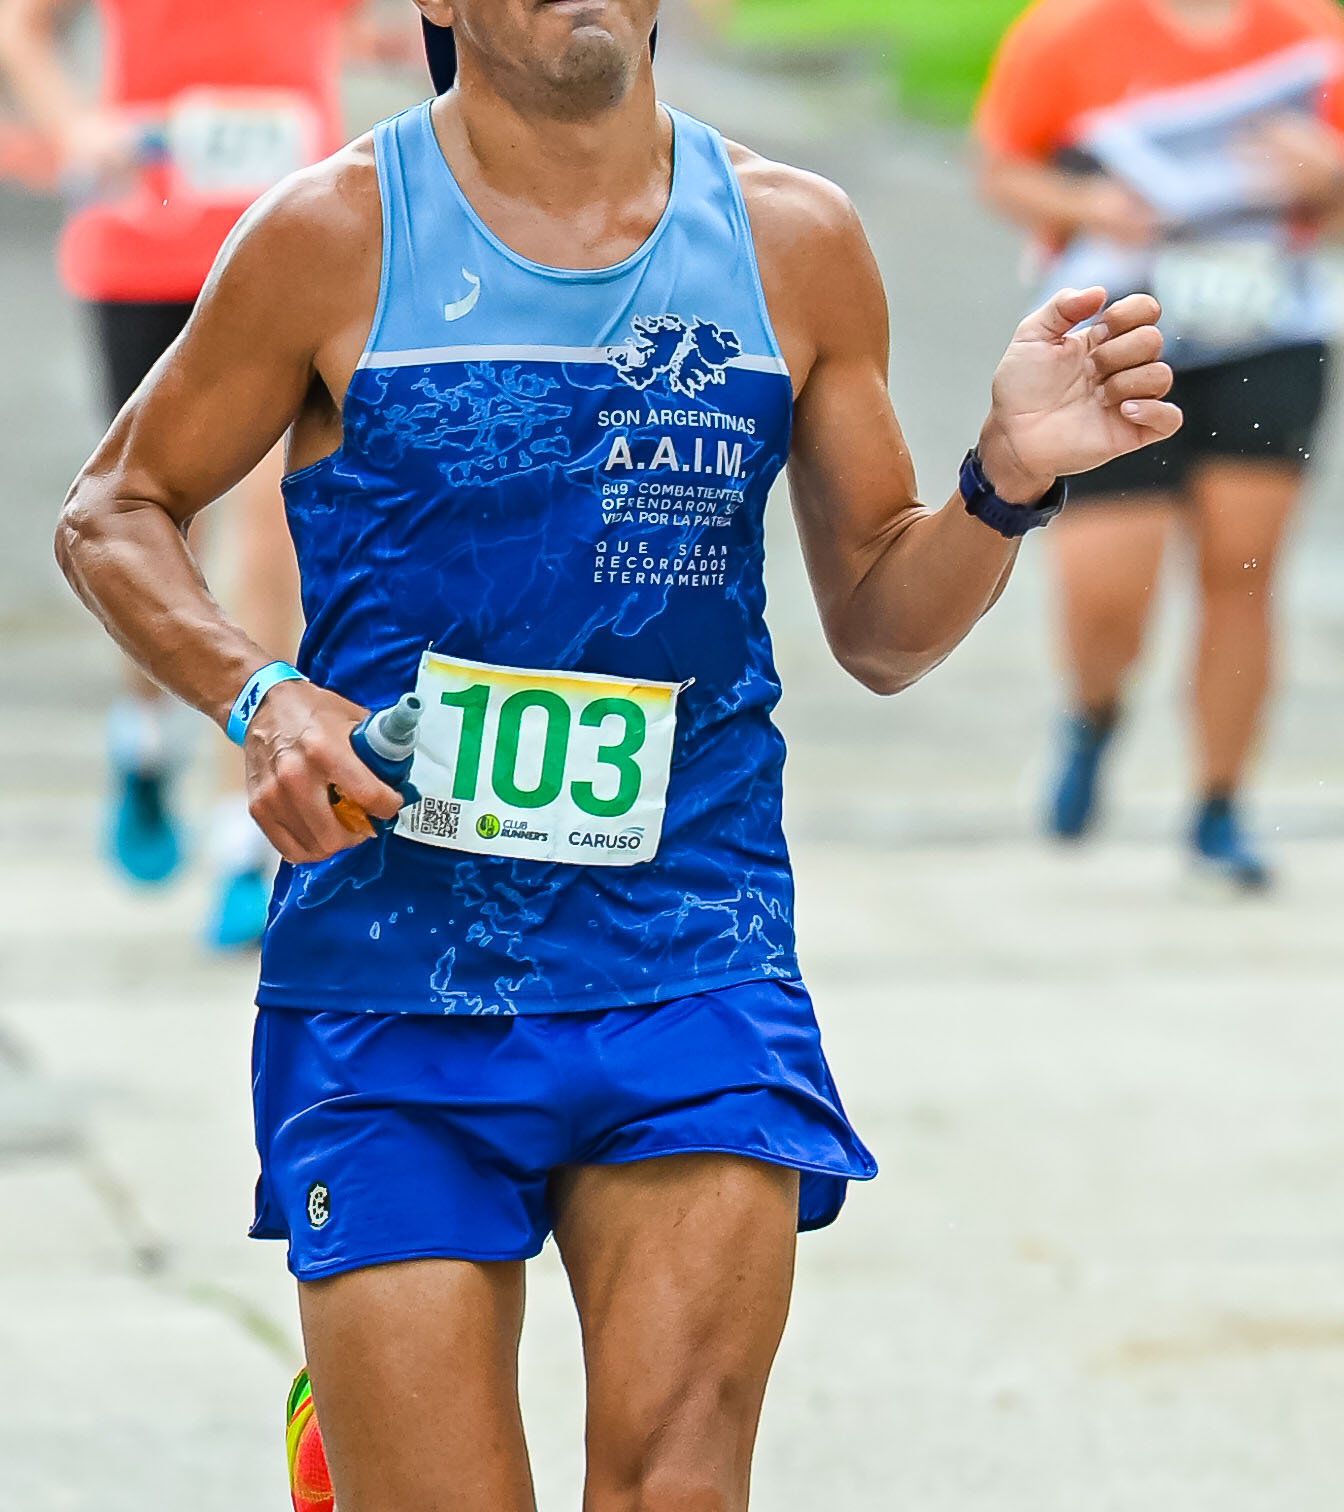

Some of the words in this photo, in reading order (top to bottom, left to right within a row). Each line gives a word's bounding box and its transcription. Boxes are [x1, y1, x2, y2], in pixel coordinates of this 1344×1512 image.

[597, 409, 640, 426] SON
[646, 409, 756, 435] ARGENTINAS
[604, 436, 747, 479] A.A.I.M.
[602, 483, 629, 496] 649
[638, 482, 744, 503] COMBATIENTES
[601, 497, 717, 514] OFRENDARON
[602, 511, 634, 525] VIDA
[638, 511, 668, 525] POR
[672, 513, 691, 526] LA
[595, 541, 649, 554] QUE
[678, 543, 727, 557] SEAN
[595, 556, 726, 572] RECORDADOS
[593, 571, 724, 587] ETERNAMENTE
[440, 683, 647, 818] 103
[502, 819, 528, 830] CLUB
[568, 831, 641, 850] CARUSO
